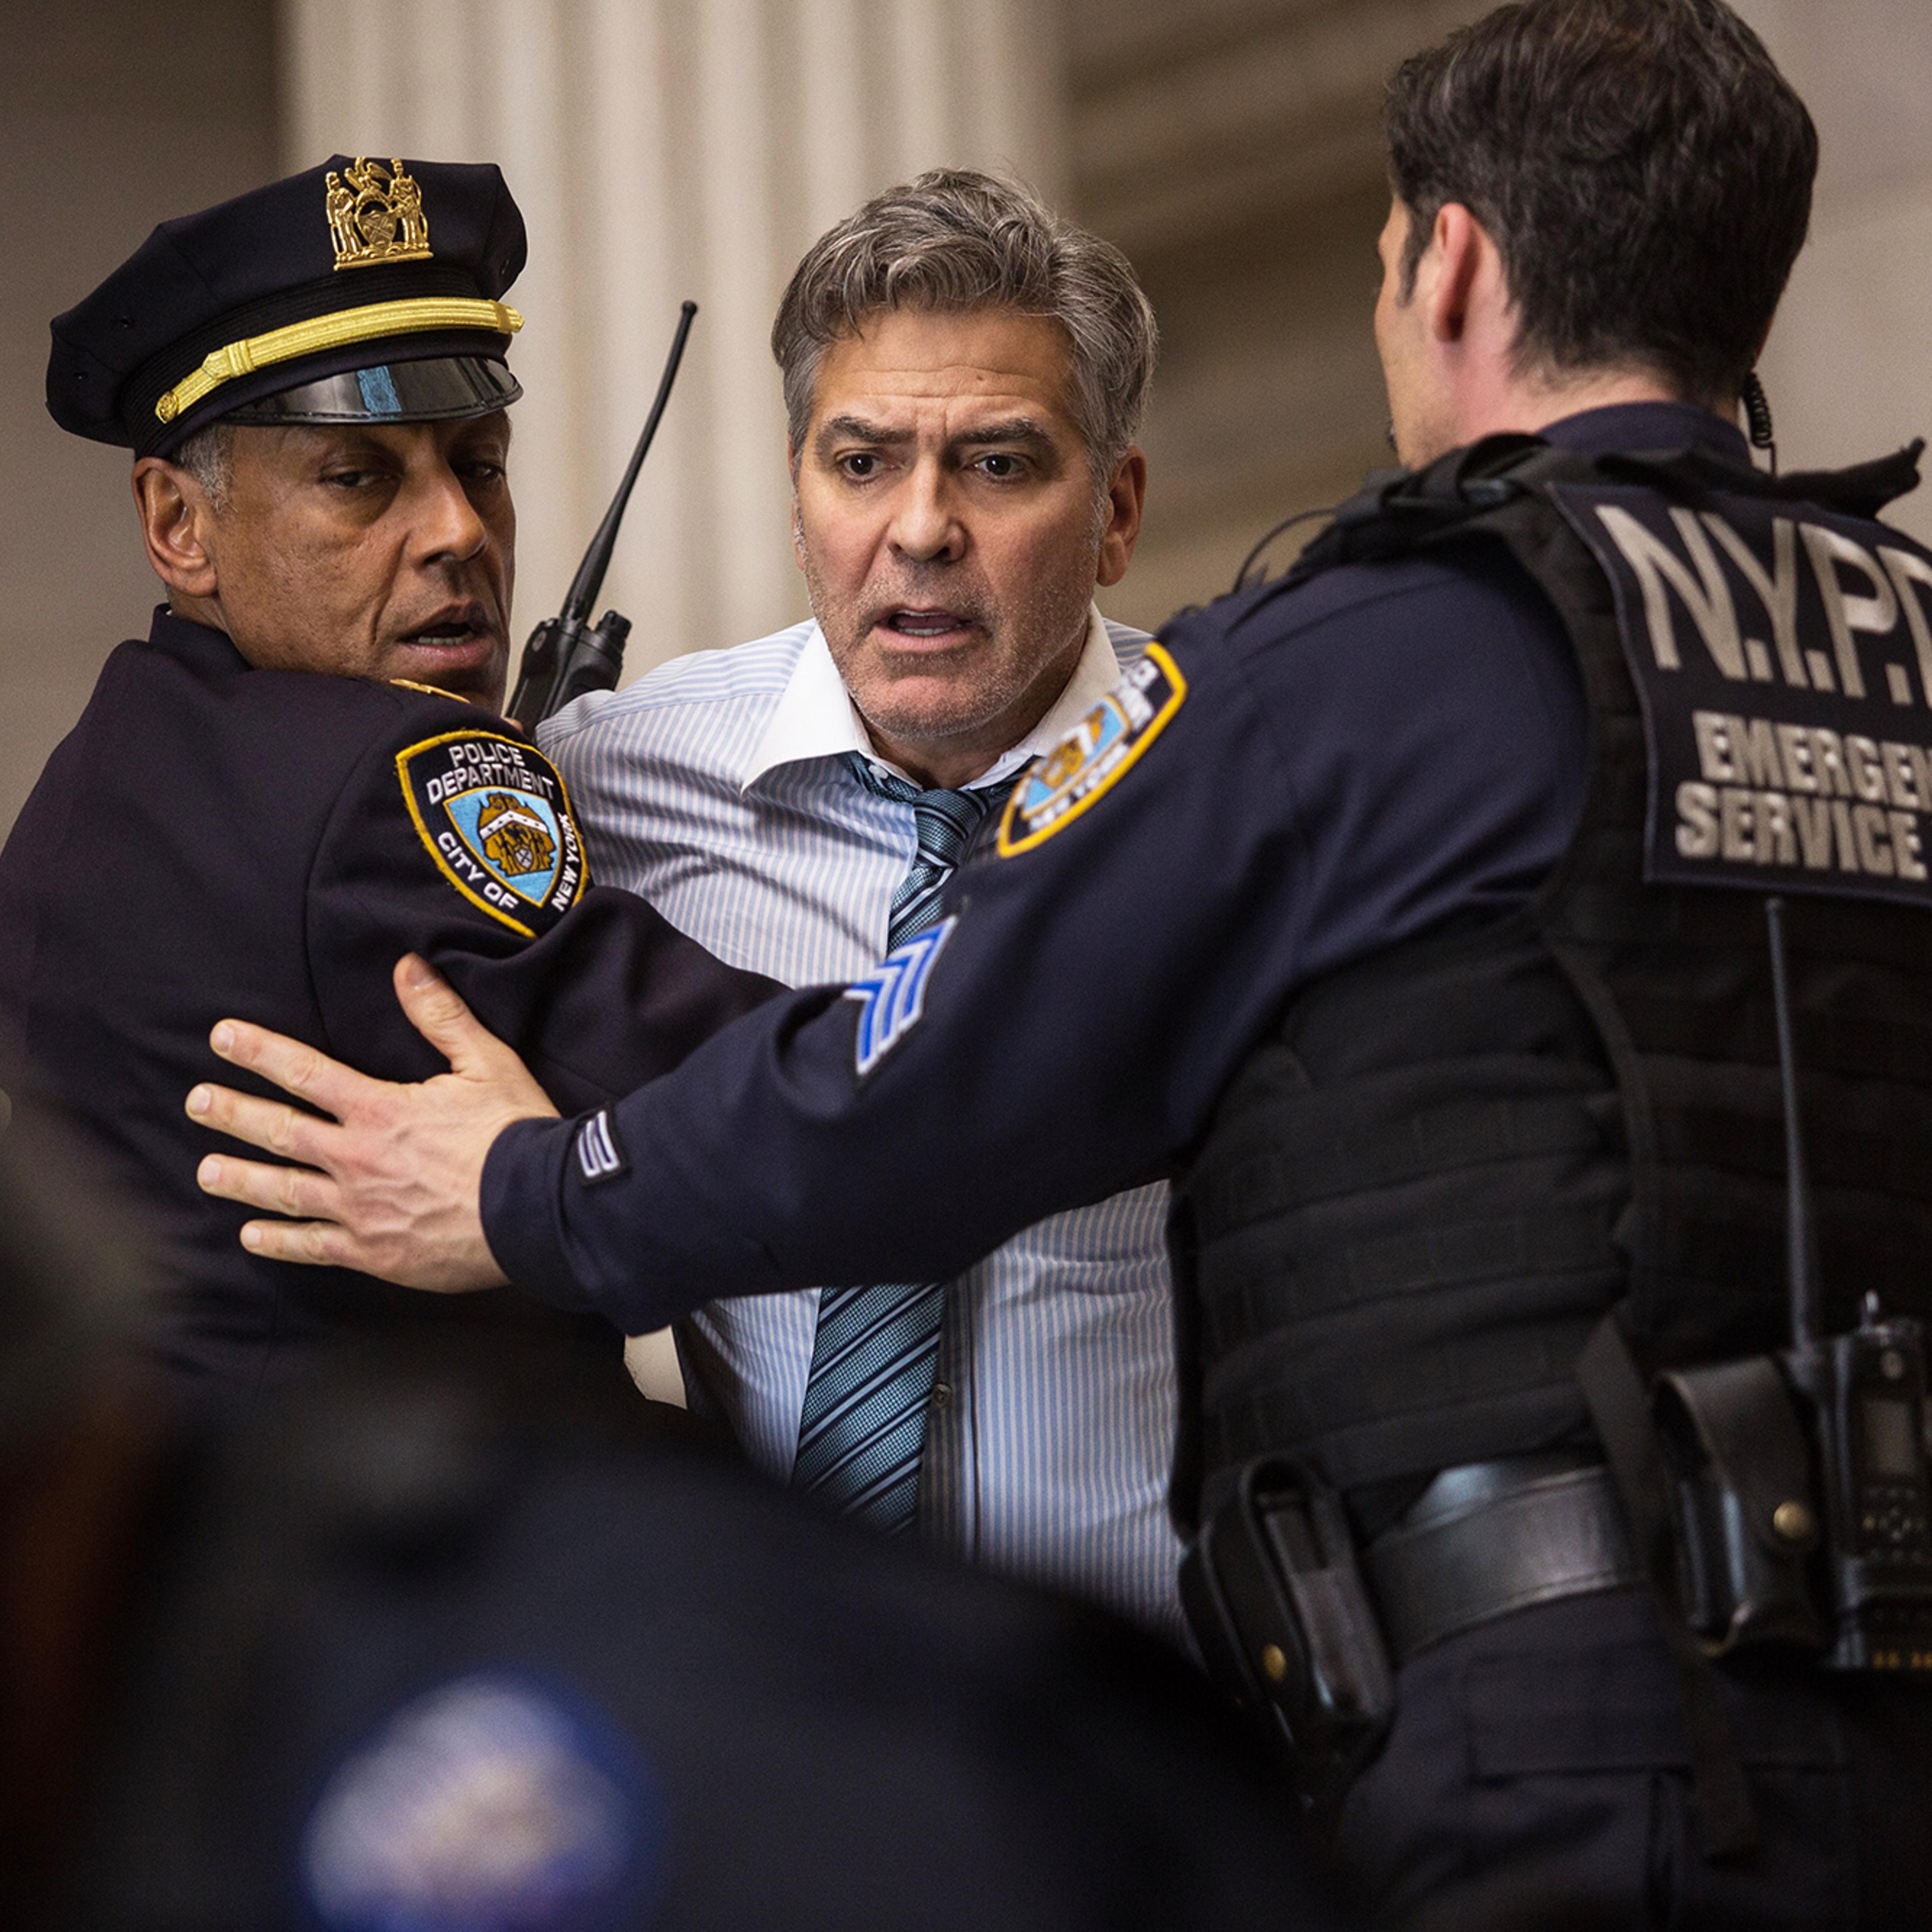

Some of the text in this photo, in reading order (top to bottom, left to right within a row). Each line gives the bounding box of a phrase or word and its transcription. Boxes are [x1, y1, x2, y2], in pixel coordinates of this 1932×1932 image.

[427, 764, 553, 804] DEPARTMENT
[449, 743, 525, 767] POLICE
[438, 812, 580, 912] CITY OF NEW YORK
[1675, 781, 1926, 880] SERVICE
